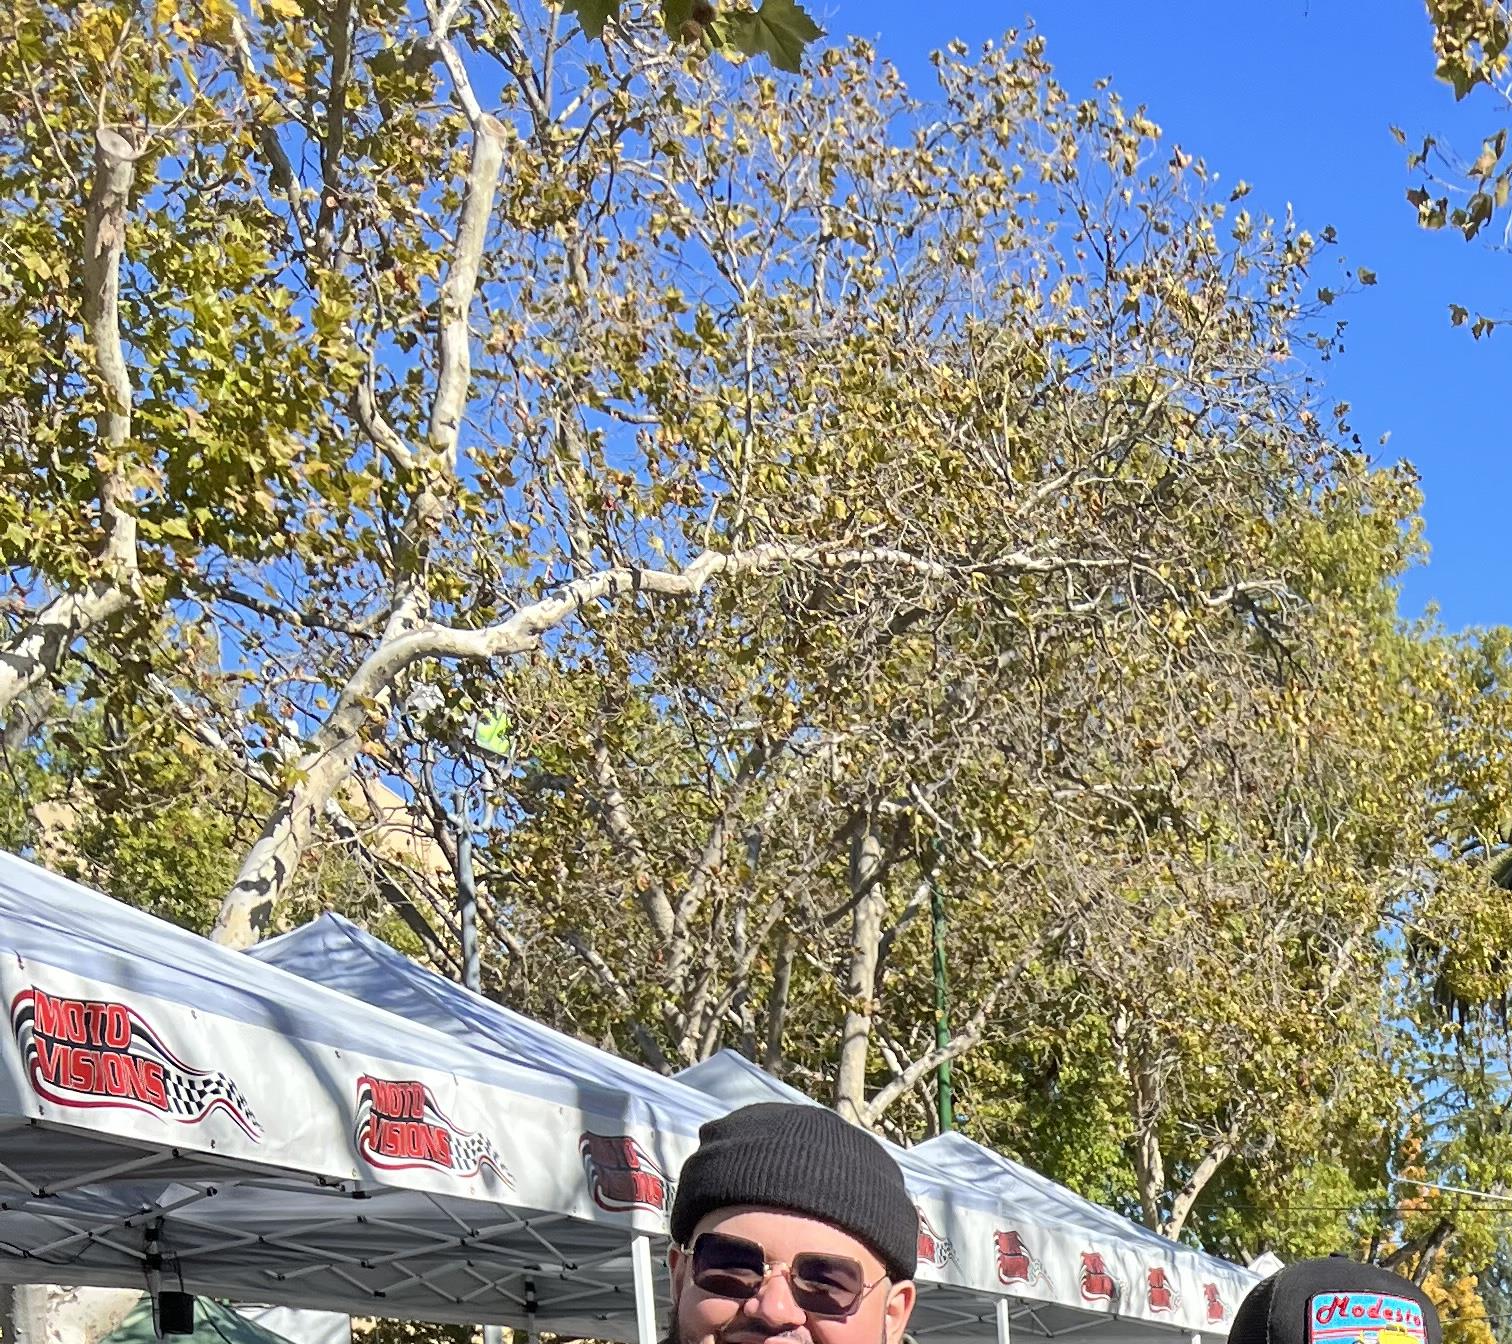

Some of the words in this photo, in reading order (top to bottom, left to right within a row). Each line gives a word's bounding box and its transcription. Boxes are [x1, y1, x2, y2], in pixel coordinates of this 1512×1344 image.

[34, 989, 132, 1049] MOTO
[34, 1035, 169, 1111] VISIONS
[369, 1076, 425, 1118] MOTO
[369, 1113, 453, 1168] VISIONS
[1316, 1295, 1421, 1326] Modesto
